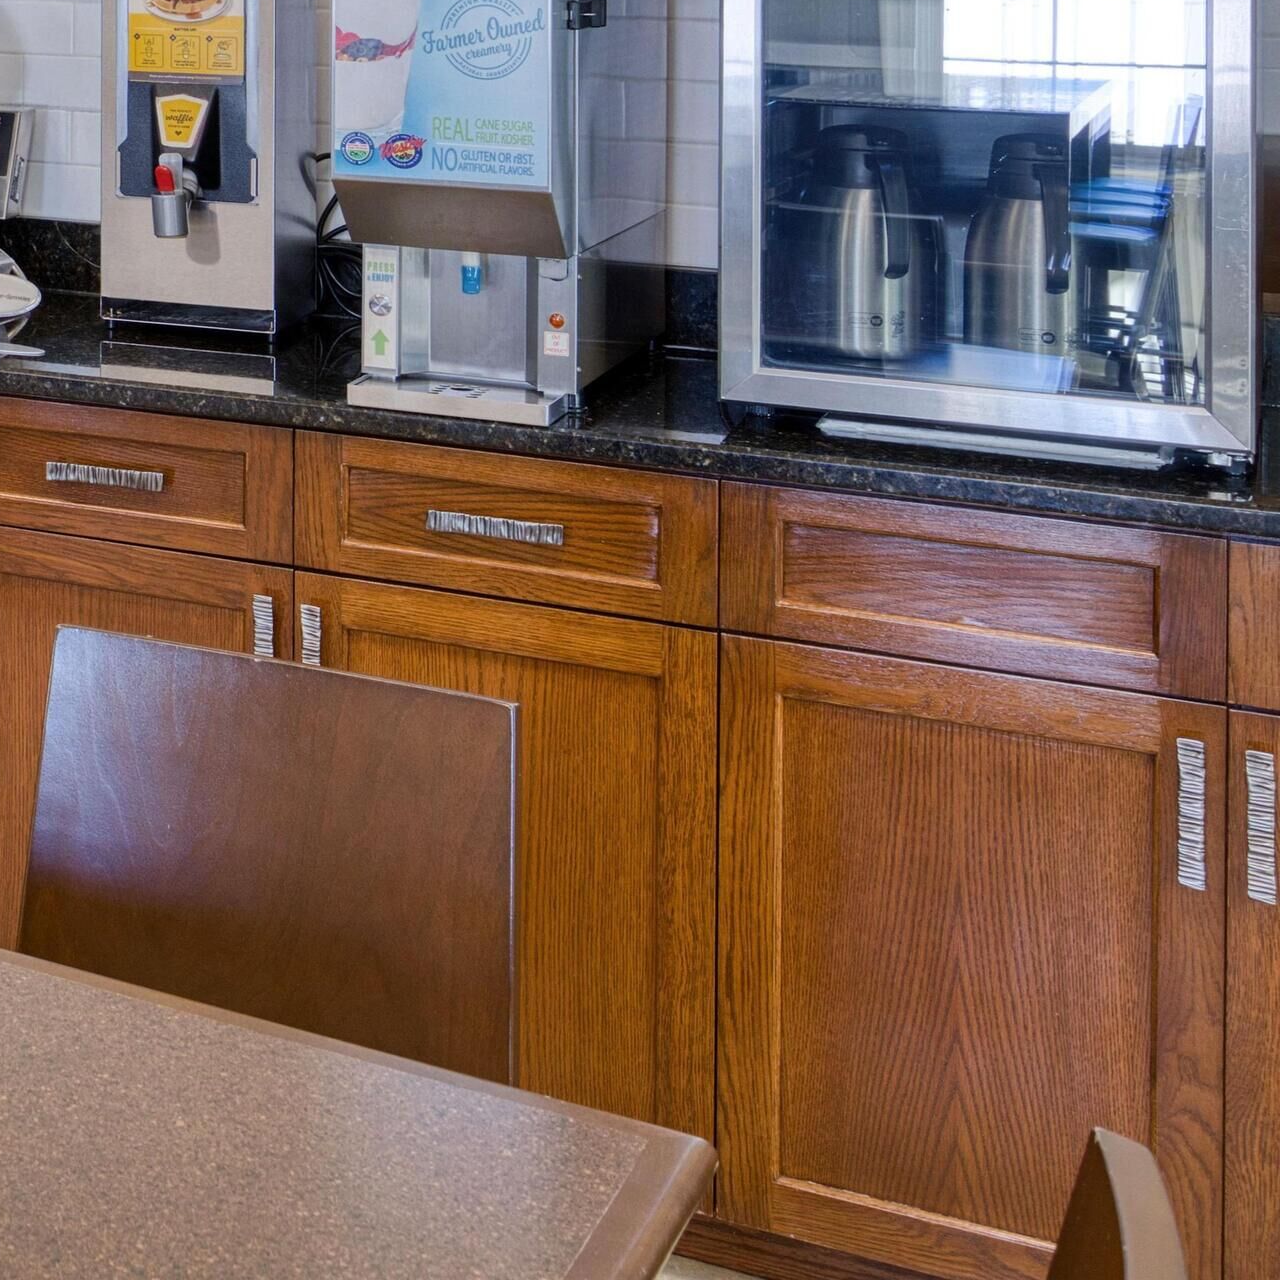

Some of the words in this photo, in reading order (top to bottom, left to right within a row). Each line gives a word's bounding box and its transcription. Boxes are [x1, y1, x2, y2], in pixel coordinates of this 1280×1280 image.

[421, 28, 486, 54] Farmer
[486, 7, 545, 40] Owned
[464, 43, 512, 60] creamery
[165, 113, 194, 122] waffle
[432, 116, 474, 141] REAL
[475, 119, 500, 130] CANE
[431, 147, 458, 171] NO
[460, 150, 496, 162] GLUTEN
[498, 152, 512, 163] OR
[458, 162, 497, 174] ARTIFICIAL
[367, 261, 395, 273] PRESS
